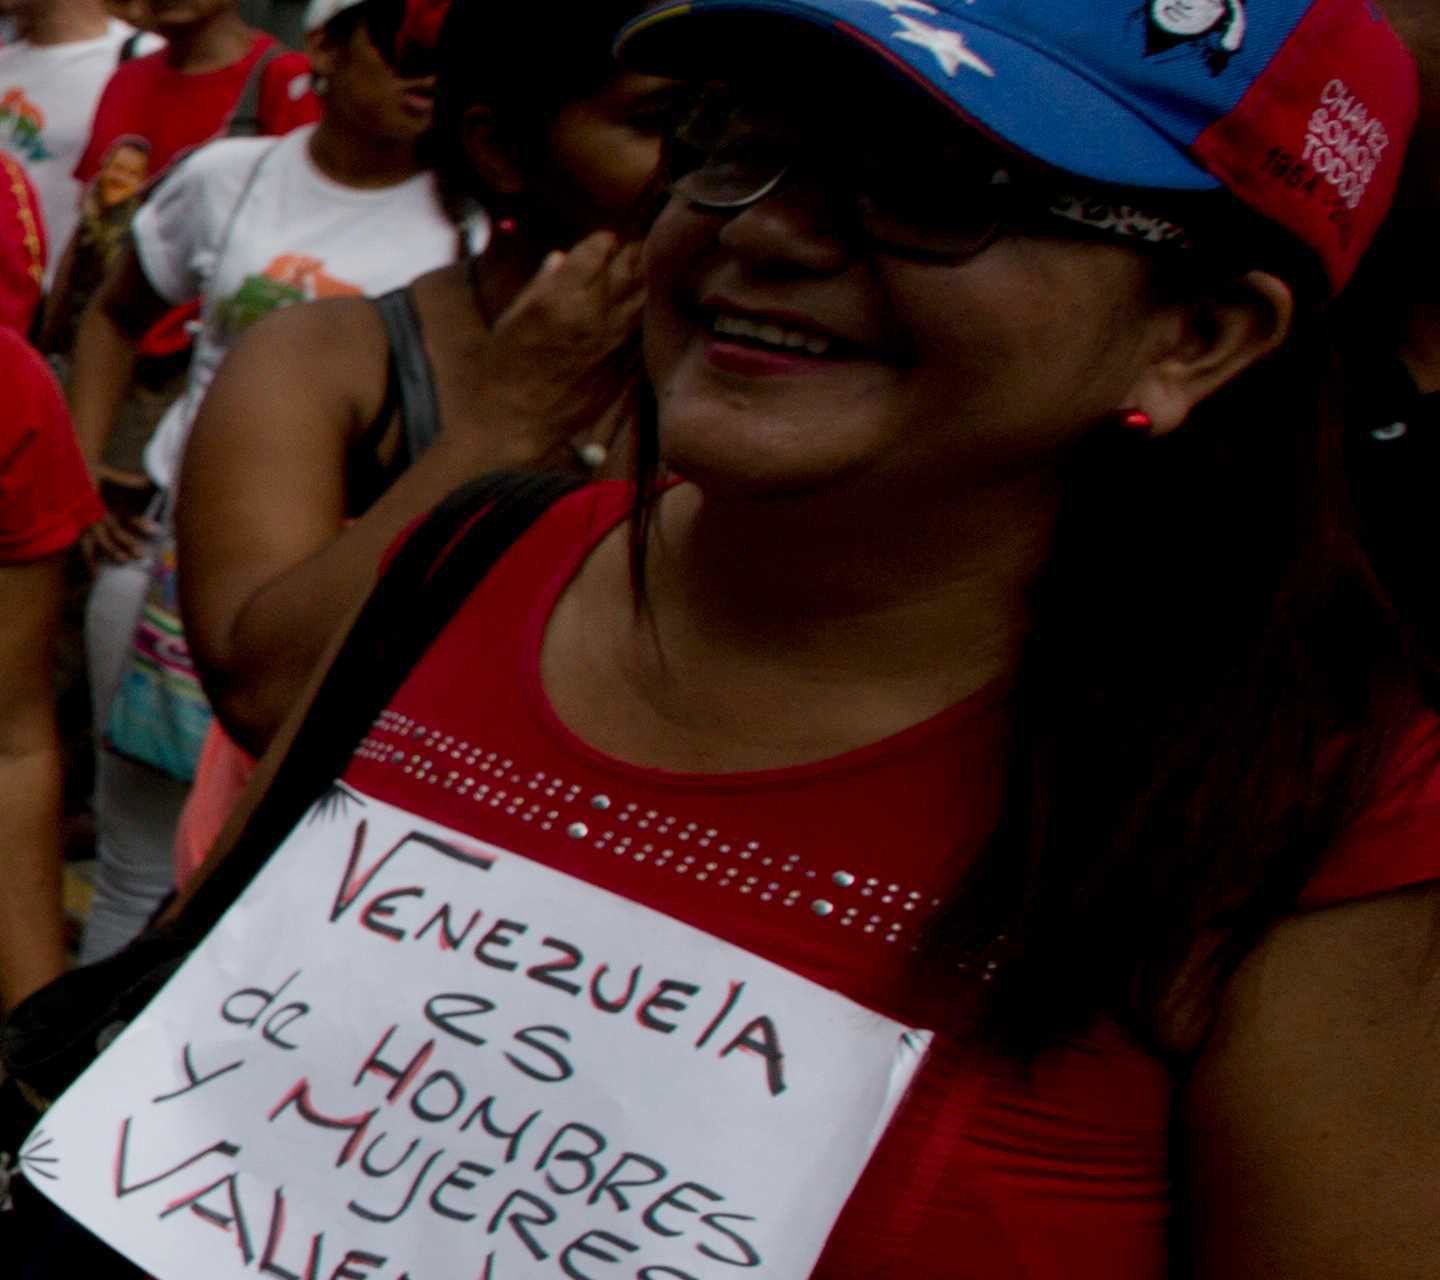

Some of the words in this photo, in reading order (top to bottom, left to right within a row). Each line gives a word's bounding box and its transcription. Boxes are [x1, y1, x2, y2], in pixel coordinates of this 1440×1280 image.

[218, 969, 312, 1052] de
[354, 1023, 763, 1269] HOMBRES
[421, 991, 576, 1085] es
